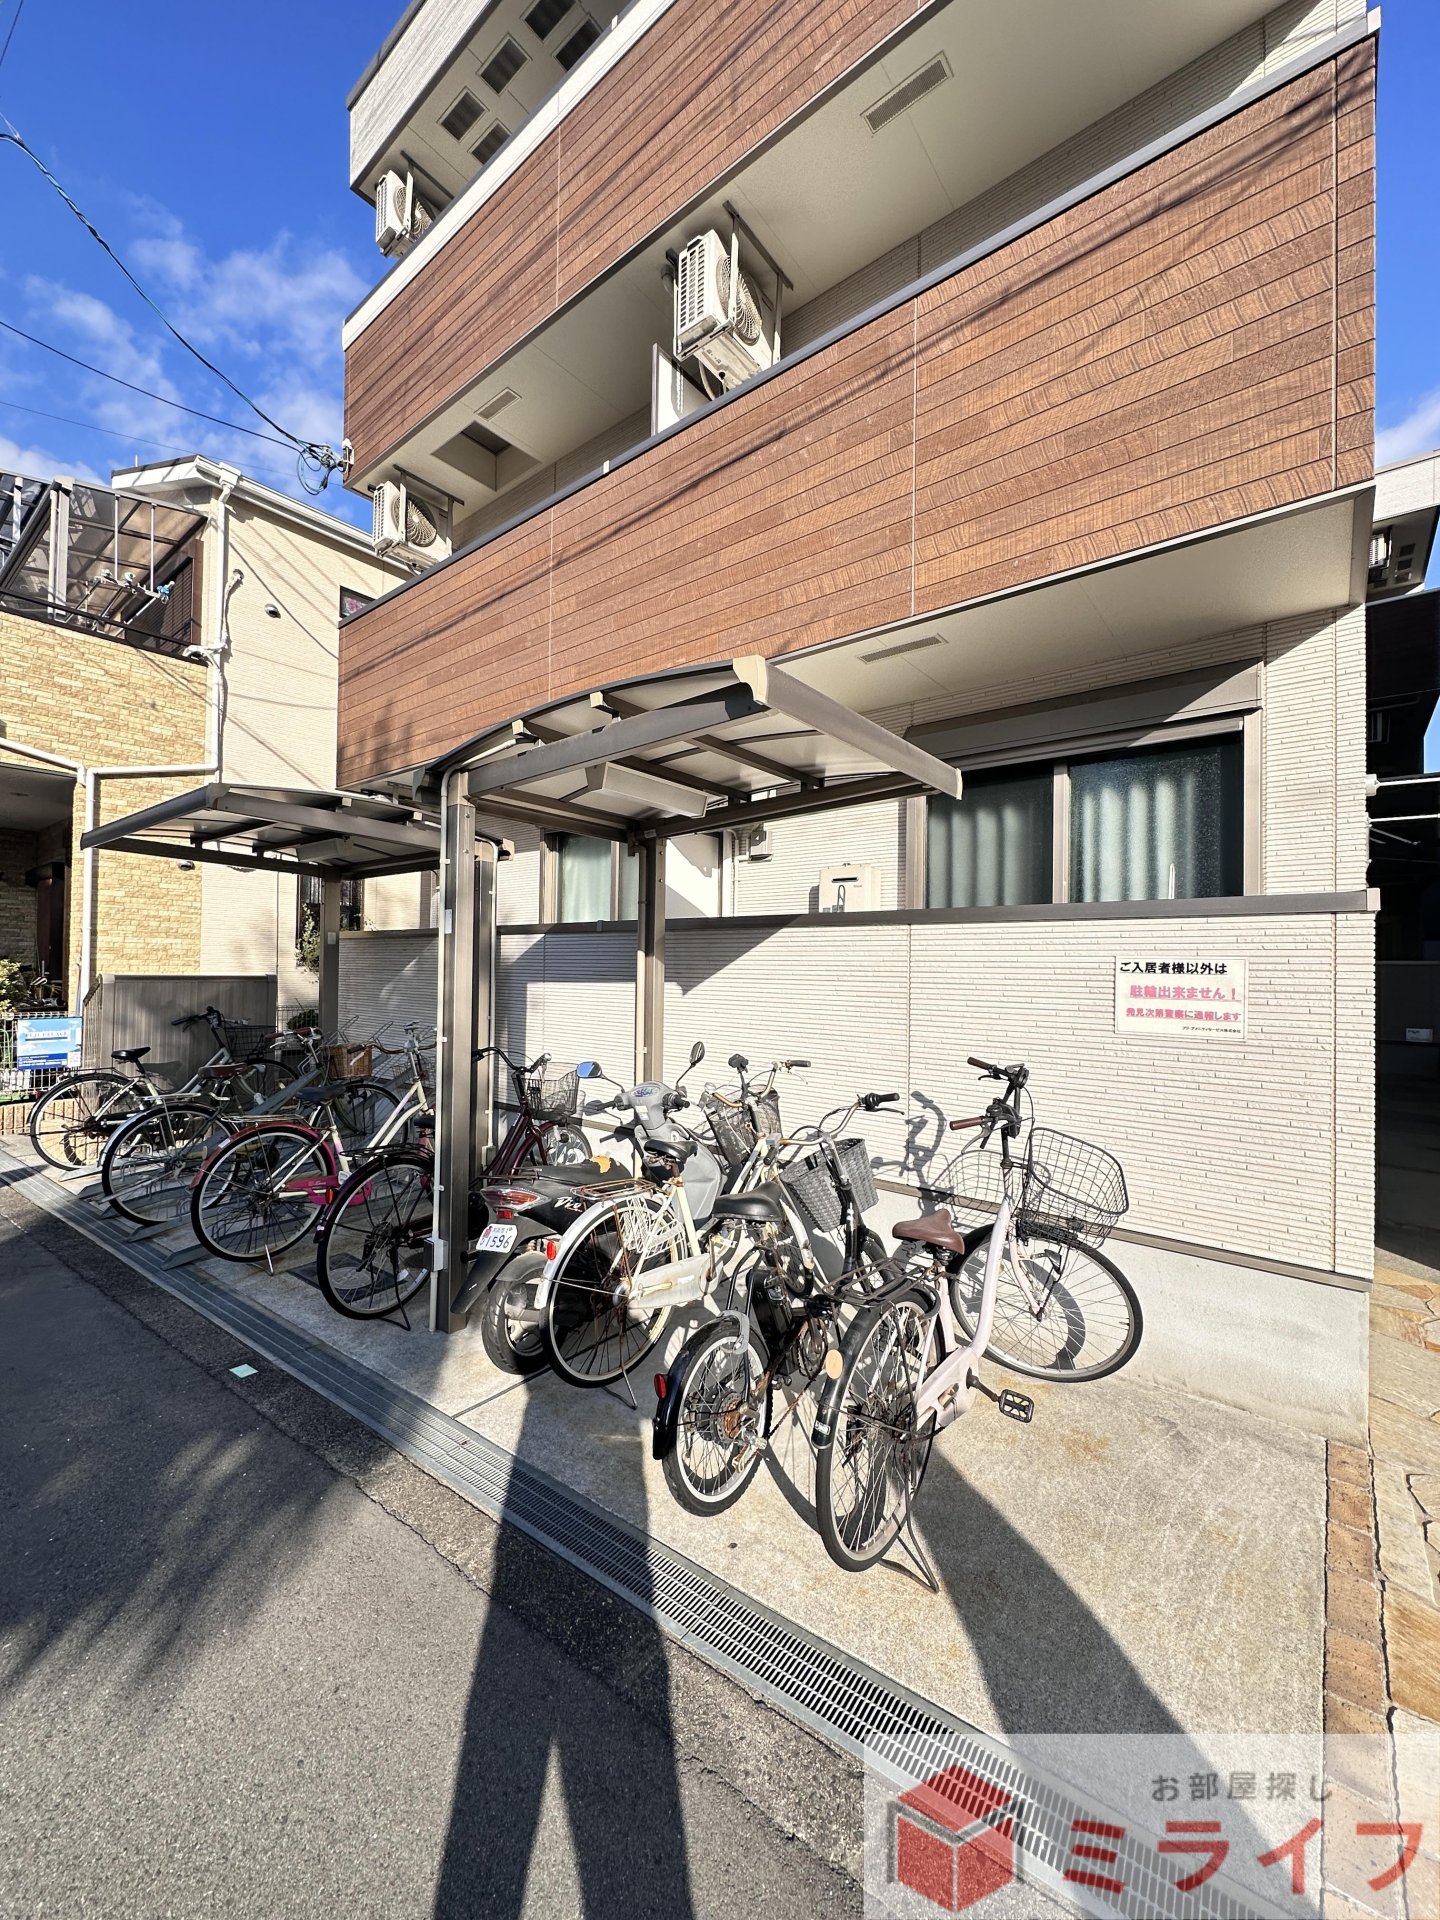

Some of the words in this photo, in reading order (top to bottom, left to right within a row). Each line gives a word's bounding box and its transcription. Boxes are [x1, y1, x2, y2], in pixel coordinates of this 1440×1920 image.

[1120, 962, 1228, 975] ご入居者様以外は
[486, 1235, 512, 1248] 1596
